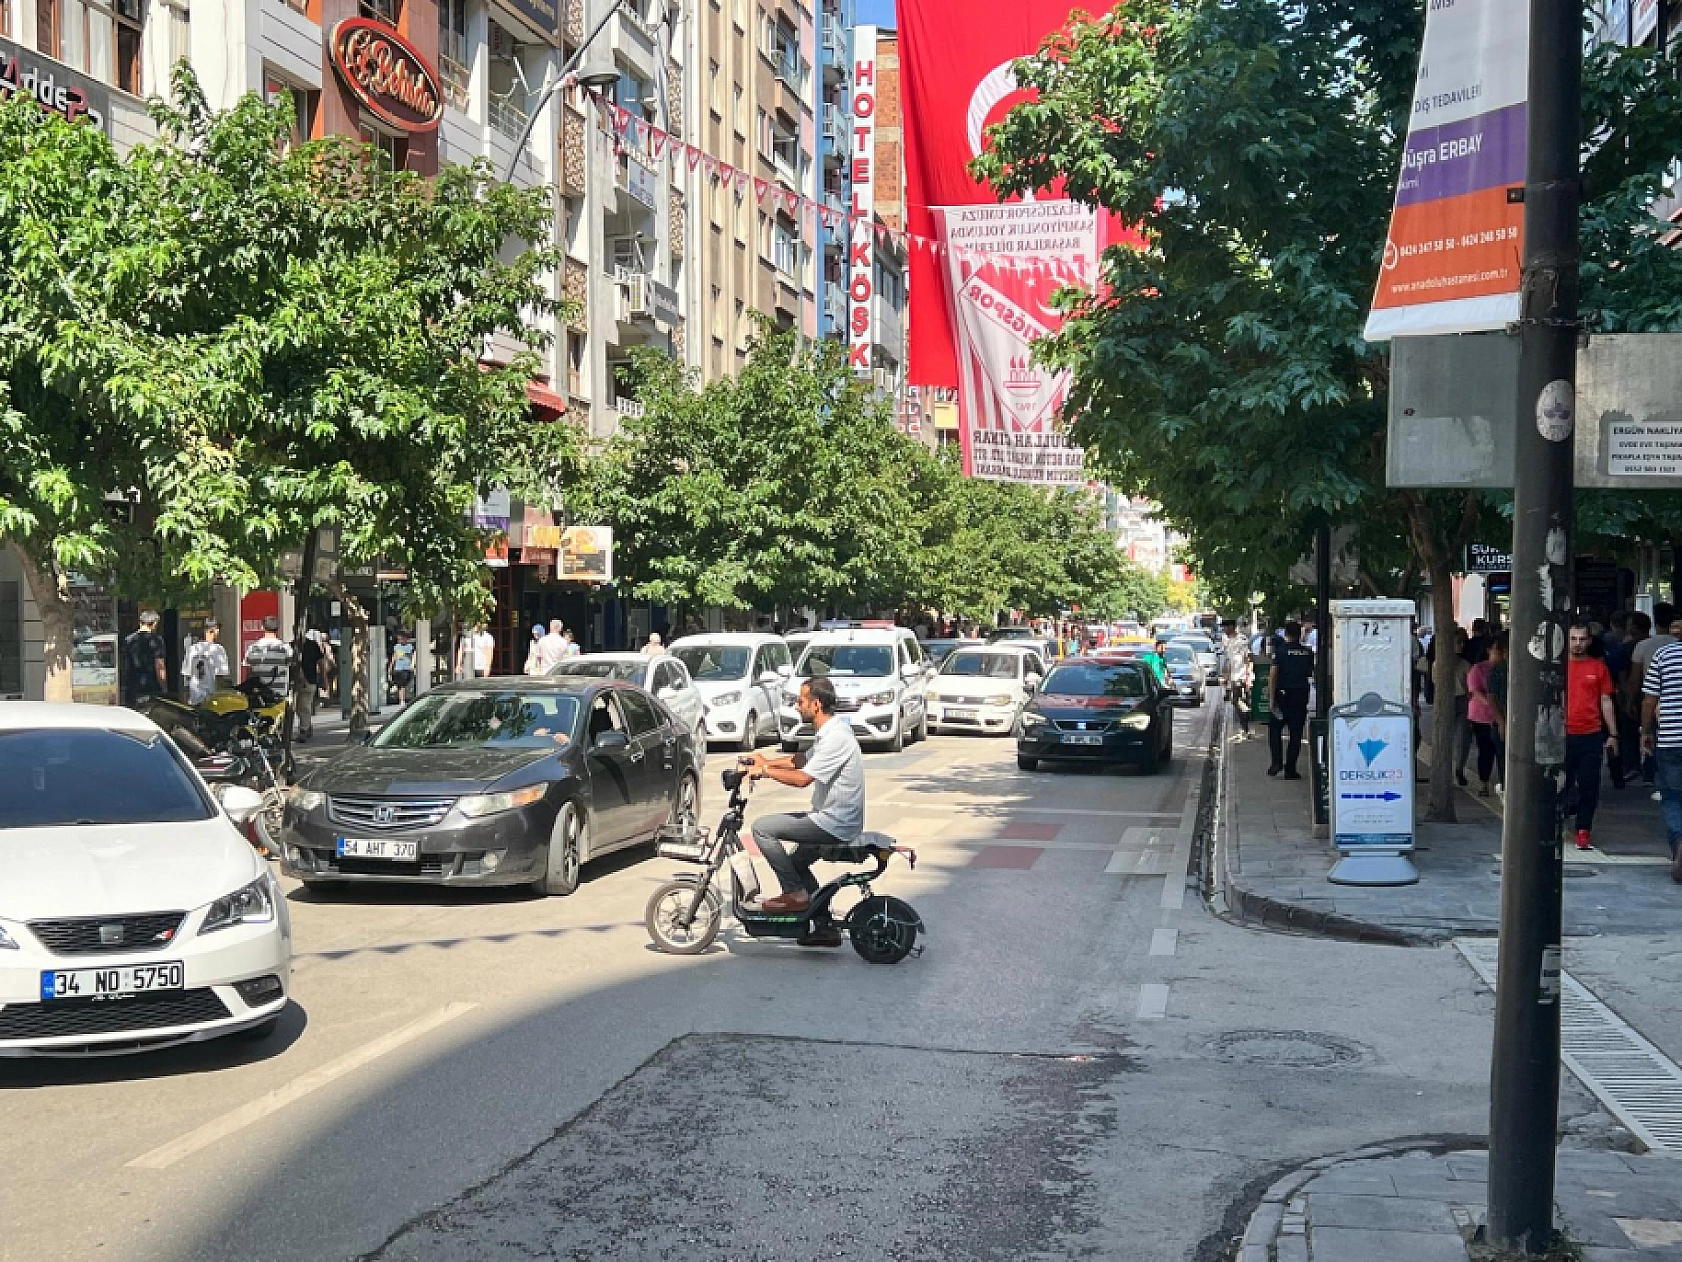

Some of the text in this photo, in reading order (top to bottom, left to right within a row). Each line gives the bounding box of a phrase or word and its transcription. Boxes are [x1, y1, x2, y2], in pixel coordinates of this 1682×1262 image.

[852, 60, 875, 217] HOTEL
[1440, 132, 1483, 161] ERBAY
[849, 242, 871, 367] KÖŞK
[56, 973, 80, 995] 34
[133, 965, 181, 989] 5750
